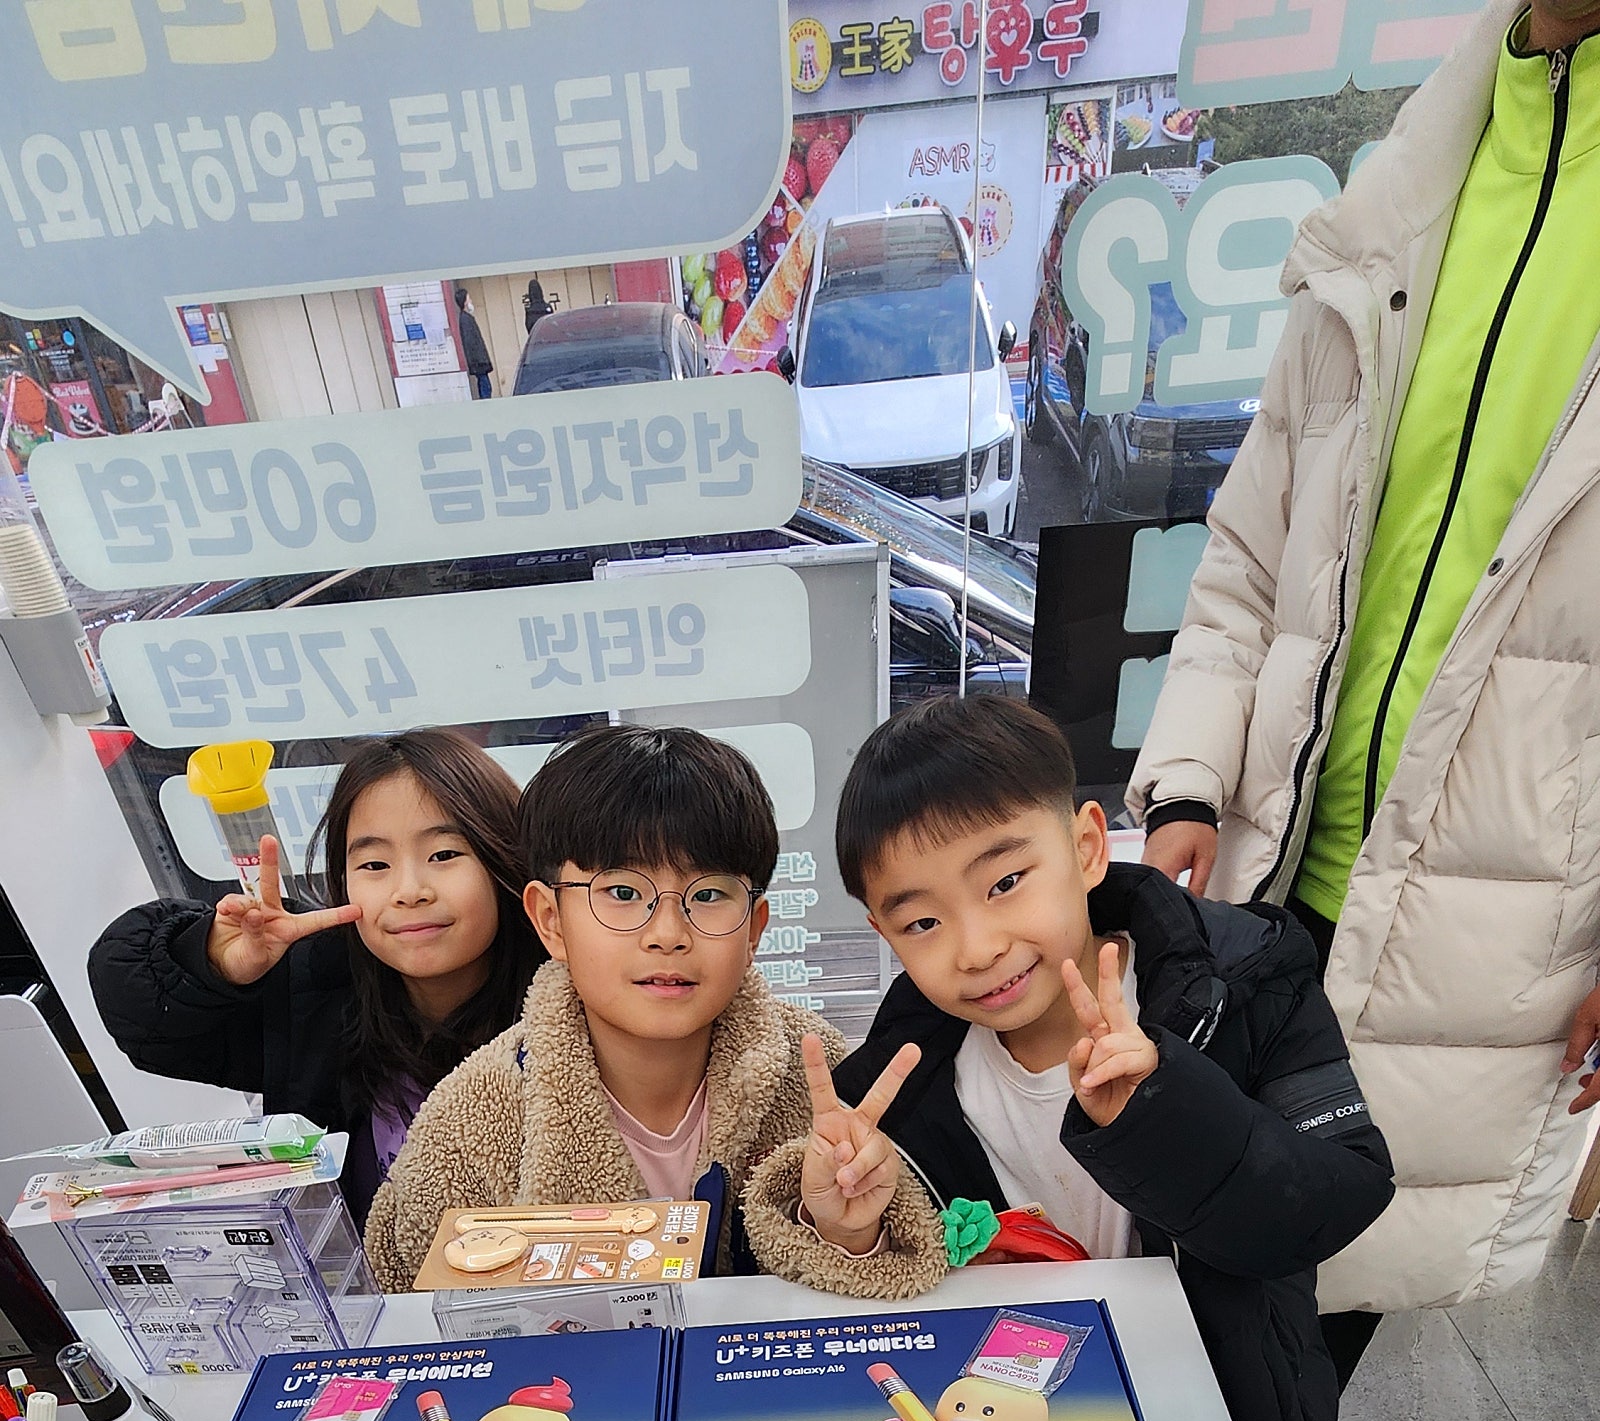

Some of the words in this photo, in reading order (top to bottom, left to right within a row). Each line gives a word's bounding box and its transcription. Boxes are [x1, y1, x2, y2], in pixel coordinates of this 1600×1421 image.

[840, 17, 914, 77] 王家
[908, 142, 971, 178] ASMR
[663, 1205, 683, 1234] 커터칼
[680, 1205, 700, 1233] 강아지
[139, 1322, 175, 1335] 서랍장
[177, 1322, 202, 1334] 투명
[718, 1335, 743, 1344] AI로
[747, 1332, 759, 1342] 더
[763, 1329, 811, 1341] 똑똑해진
[815, 1327, 839, 1337] 우리
[843, 1325, 867, 1335] 아이
[871, 1321, 920, 1333] 안심케어
[823, 1333, 936, 1356] 무너에디션
[292, 1362, 317, 1371] AI로
[320, 1359, 333, 1369] 더
[336, 1356, 382, 1368] 똑똑해진
[385, 1354, 409, 1365] 우리
[412, 1352, 436, 1362] 아이
[439, 1349, 486, 1360] 안심케어
[980, 1362, 1009, 1375] NANO
[385, 1361, 494, 1382] 무너에디션
[715, 1369, 780, 1382] SAMSUNG
[783, 1366, 826, 1377] Galaxy
[826, 1365, 846, 1373] A16
